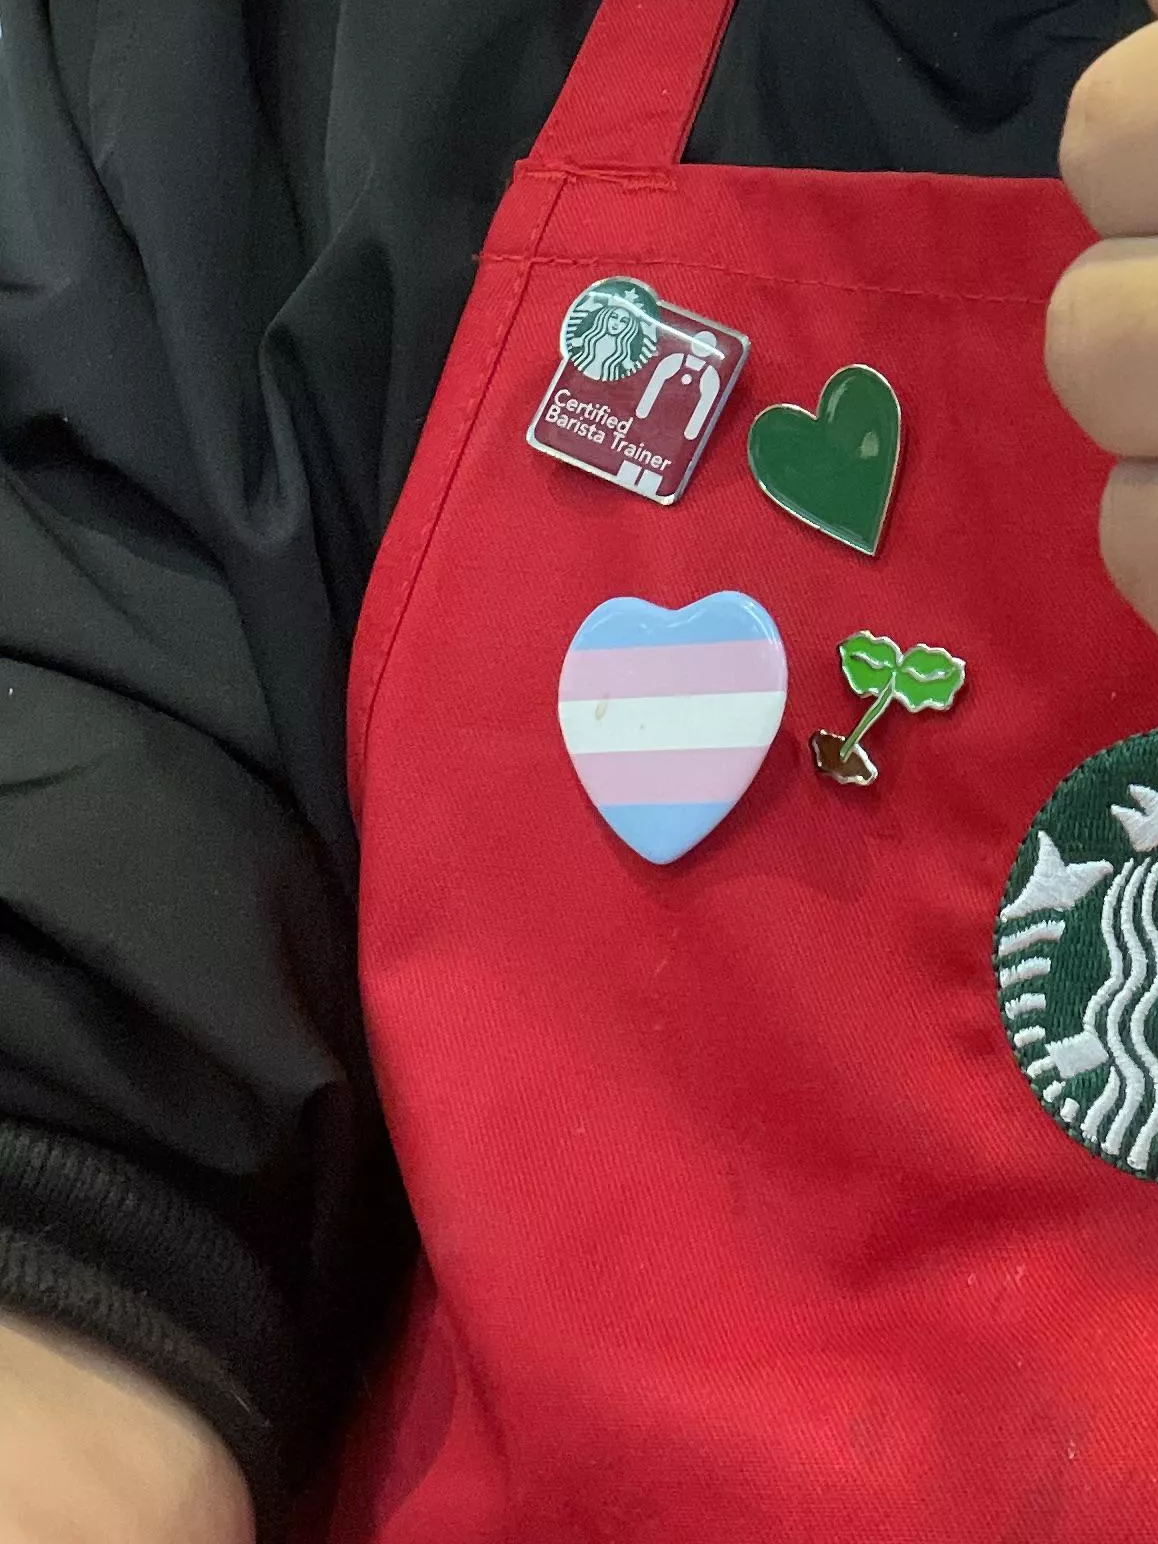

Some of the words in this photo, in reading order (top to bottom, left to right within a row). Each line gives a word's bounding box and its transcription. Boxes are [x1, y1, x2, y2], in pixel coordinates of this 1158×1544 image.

[545, 406, 605, 444] Barista
[610, 430, 671, 471] Trainer
[553, 389, 633, 434] Certified
